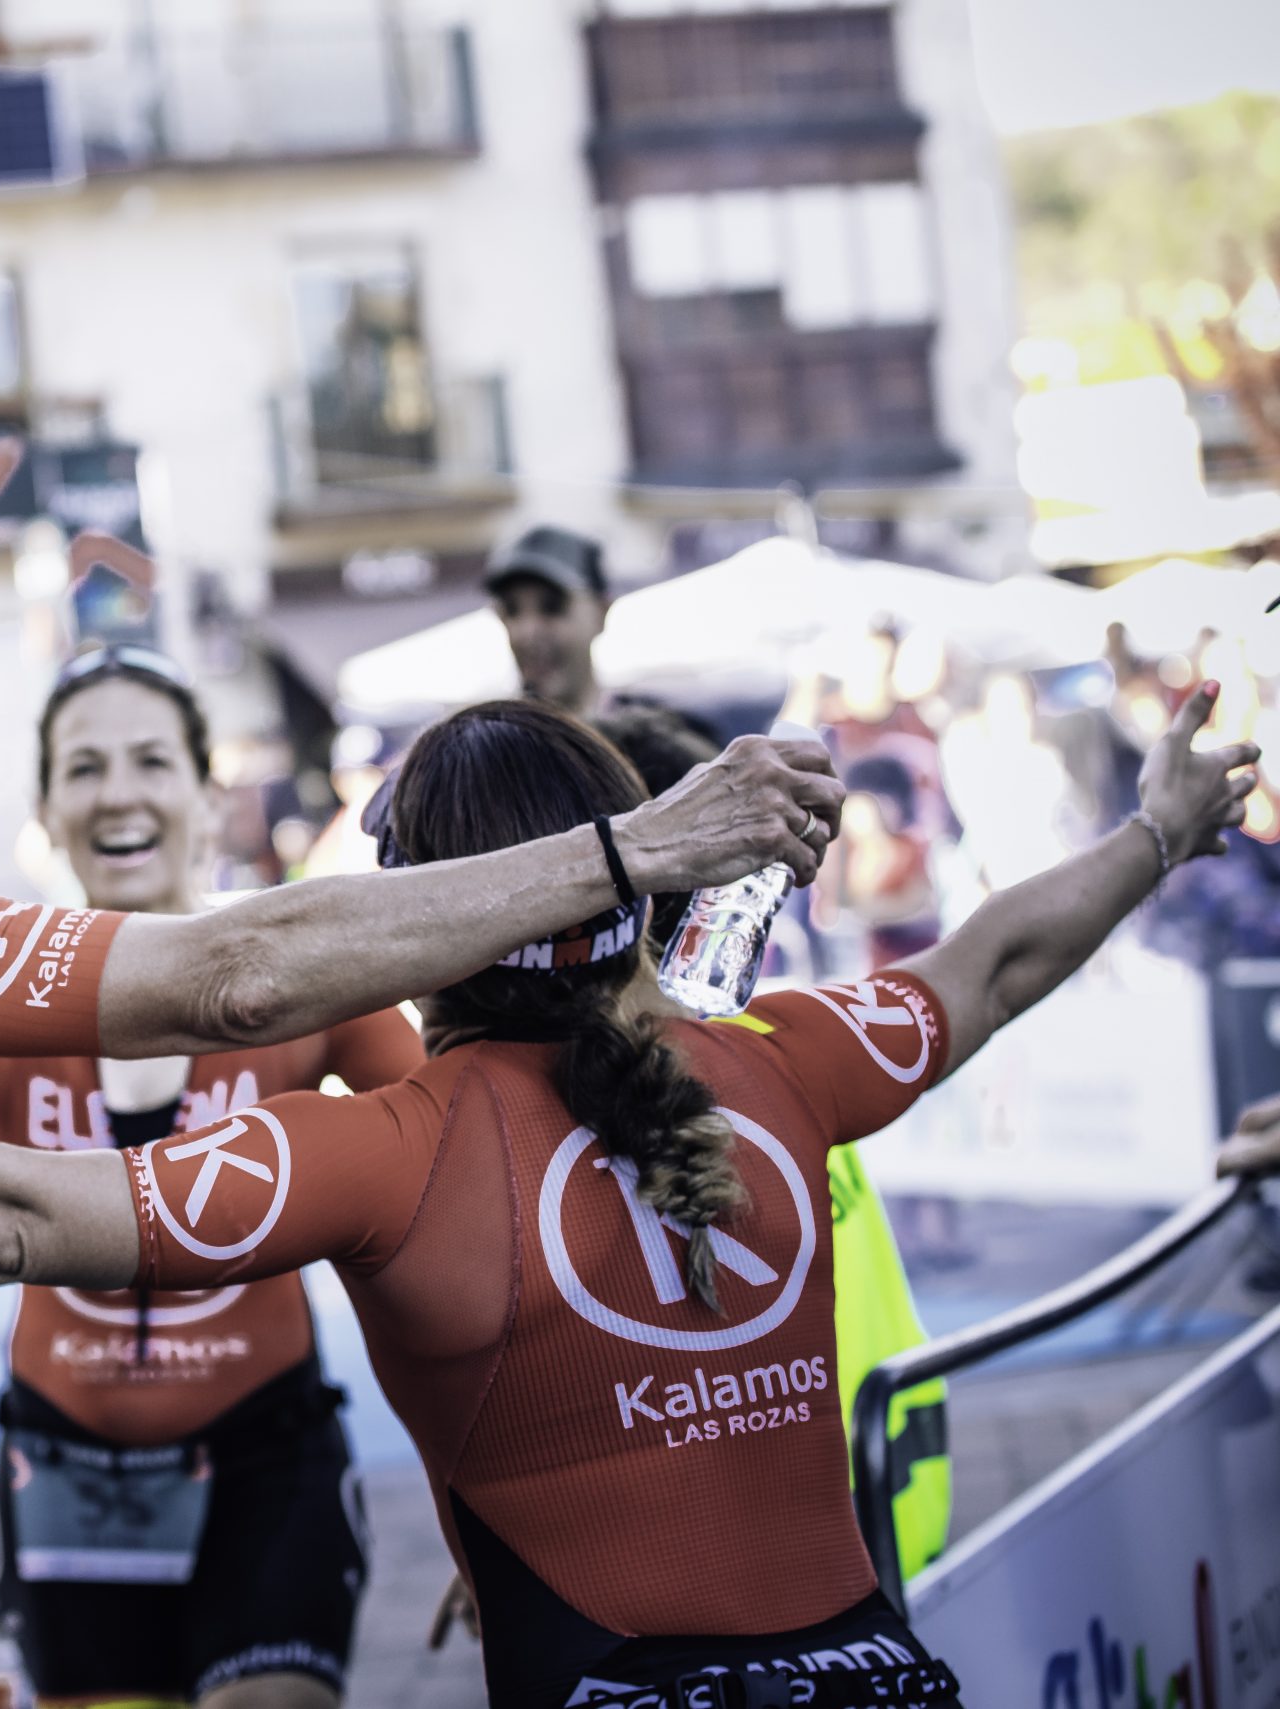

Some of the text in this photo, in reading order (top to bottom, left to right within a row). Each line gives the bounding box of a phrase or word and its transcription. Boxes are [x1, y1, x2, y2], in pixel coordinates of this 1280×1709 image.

[25, 908, 90, 1009] Kalam
[614, 1356, 828, 1429] Kalamos
[665, 1402, 811, 1448] LAS ROZAS
